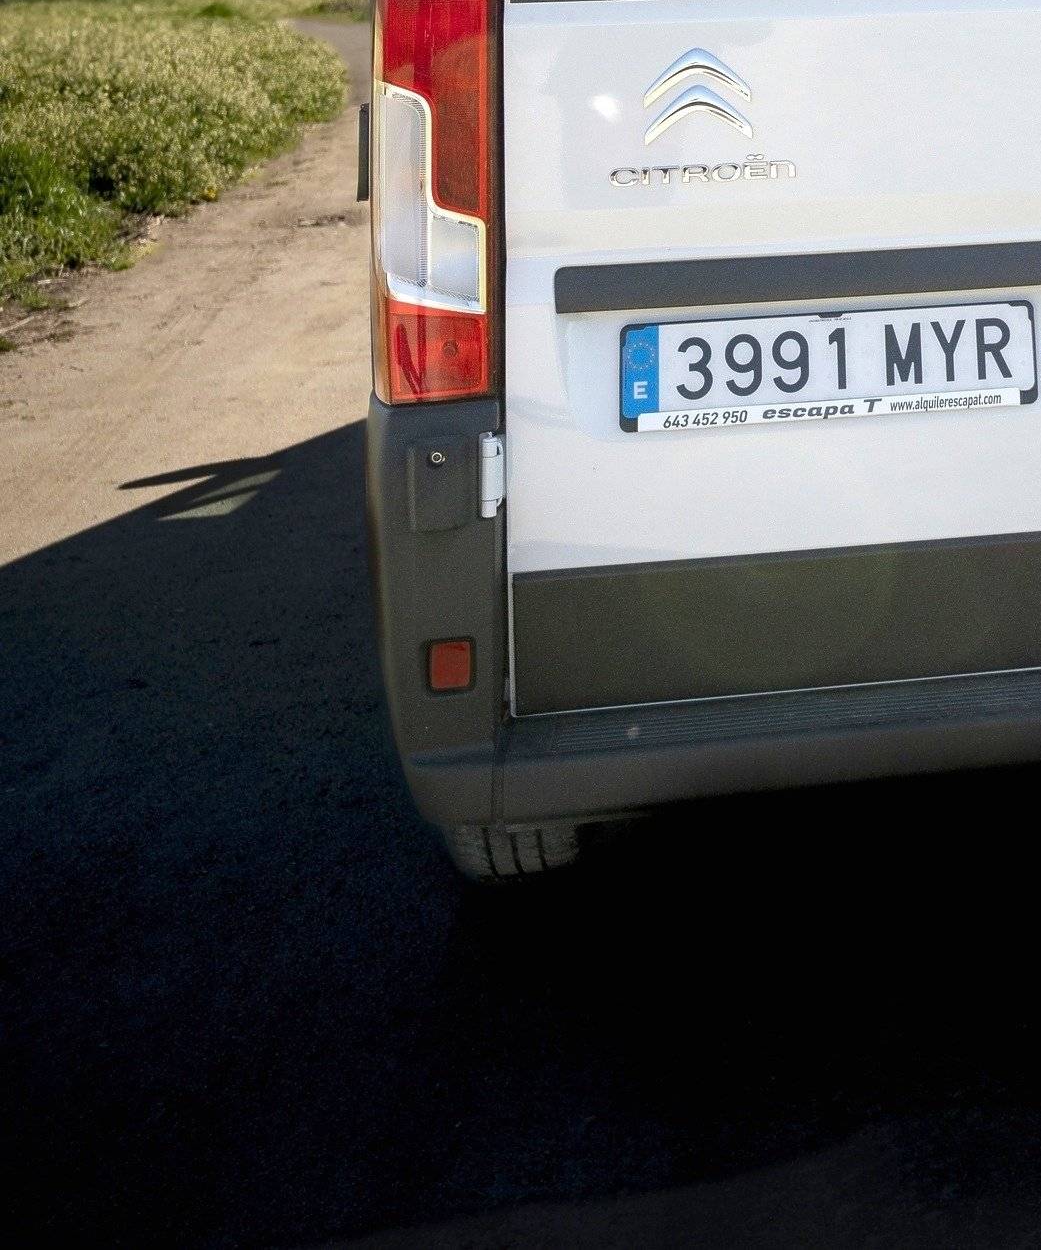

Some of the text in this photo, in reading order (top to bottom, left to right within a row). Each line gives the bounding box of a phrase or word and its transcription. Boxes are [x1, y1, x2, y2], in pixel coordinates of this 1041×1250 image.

[676, 327, 847, 400] 3991
[884, 317, 1013, 387] MYR
[633, 381, 648, 400] E
[663, 393, 1002, 429] 643 452 950 escapa T www.alquilerescapat.com
